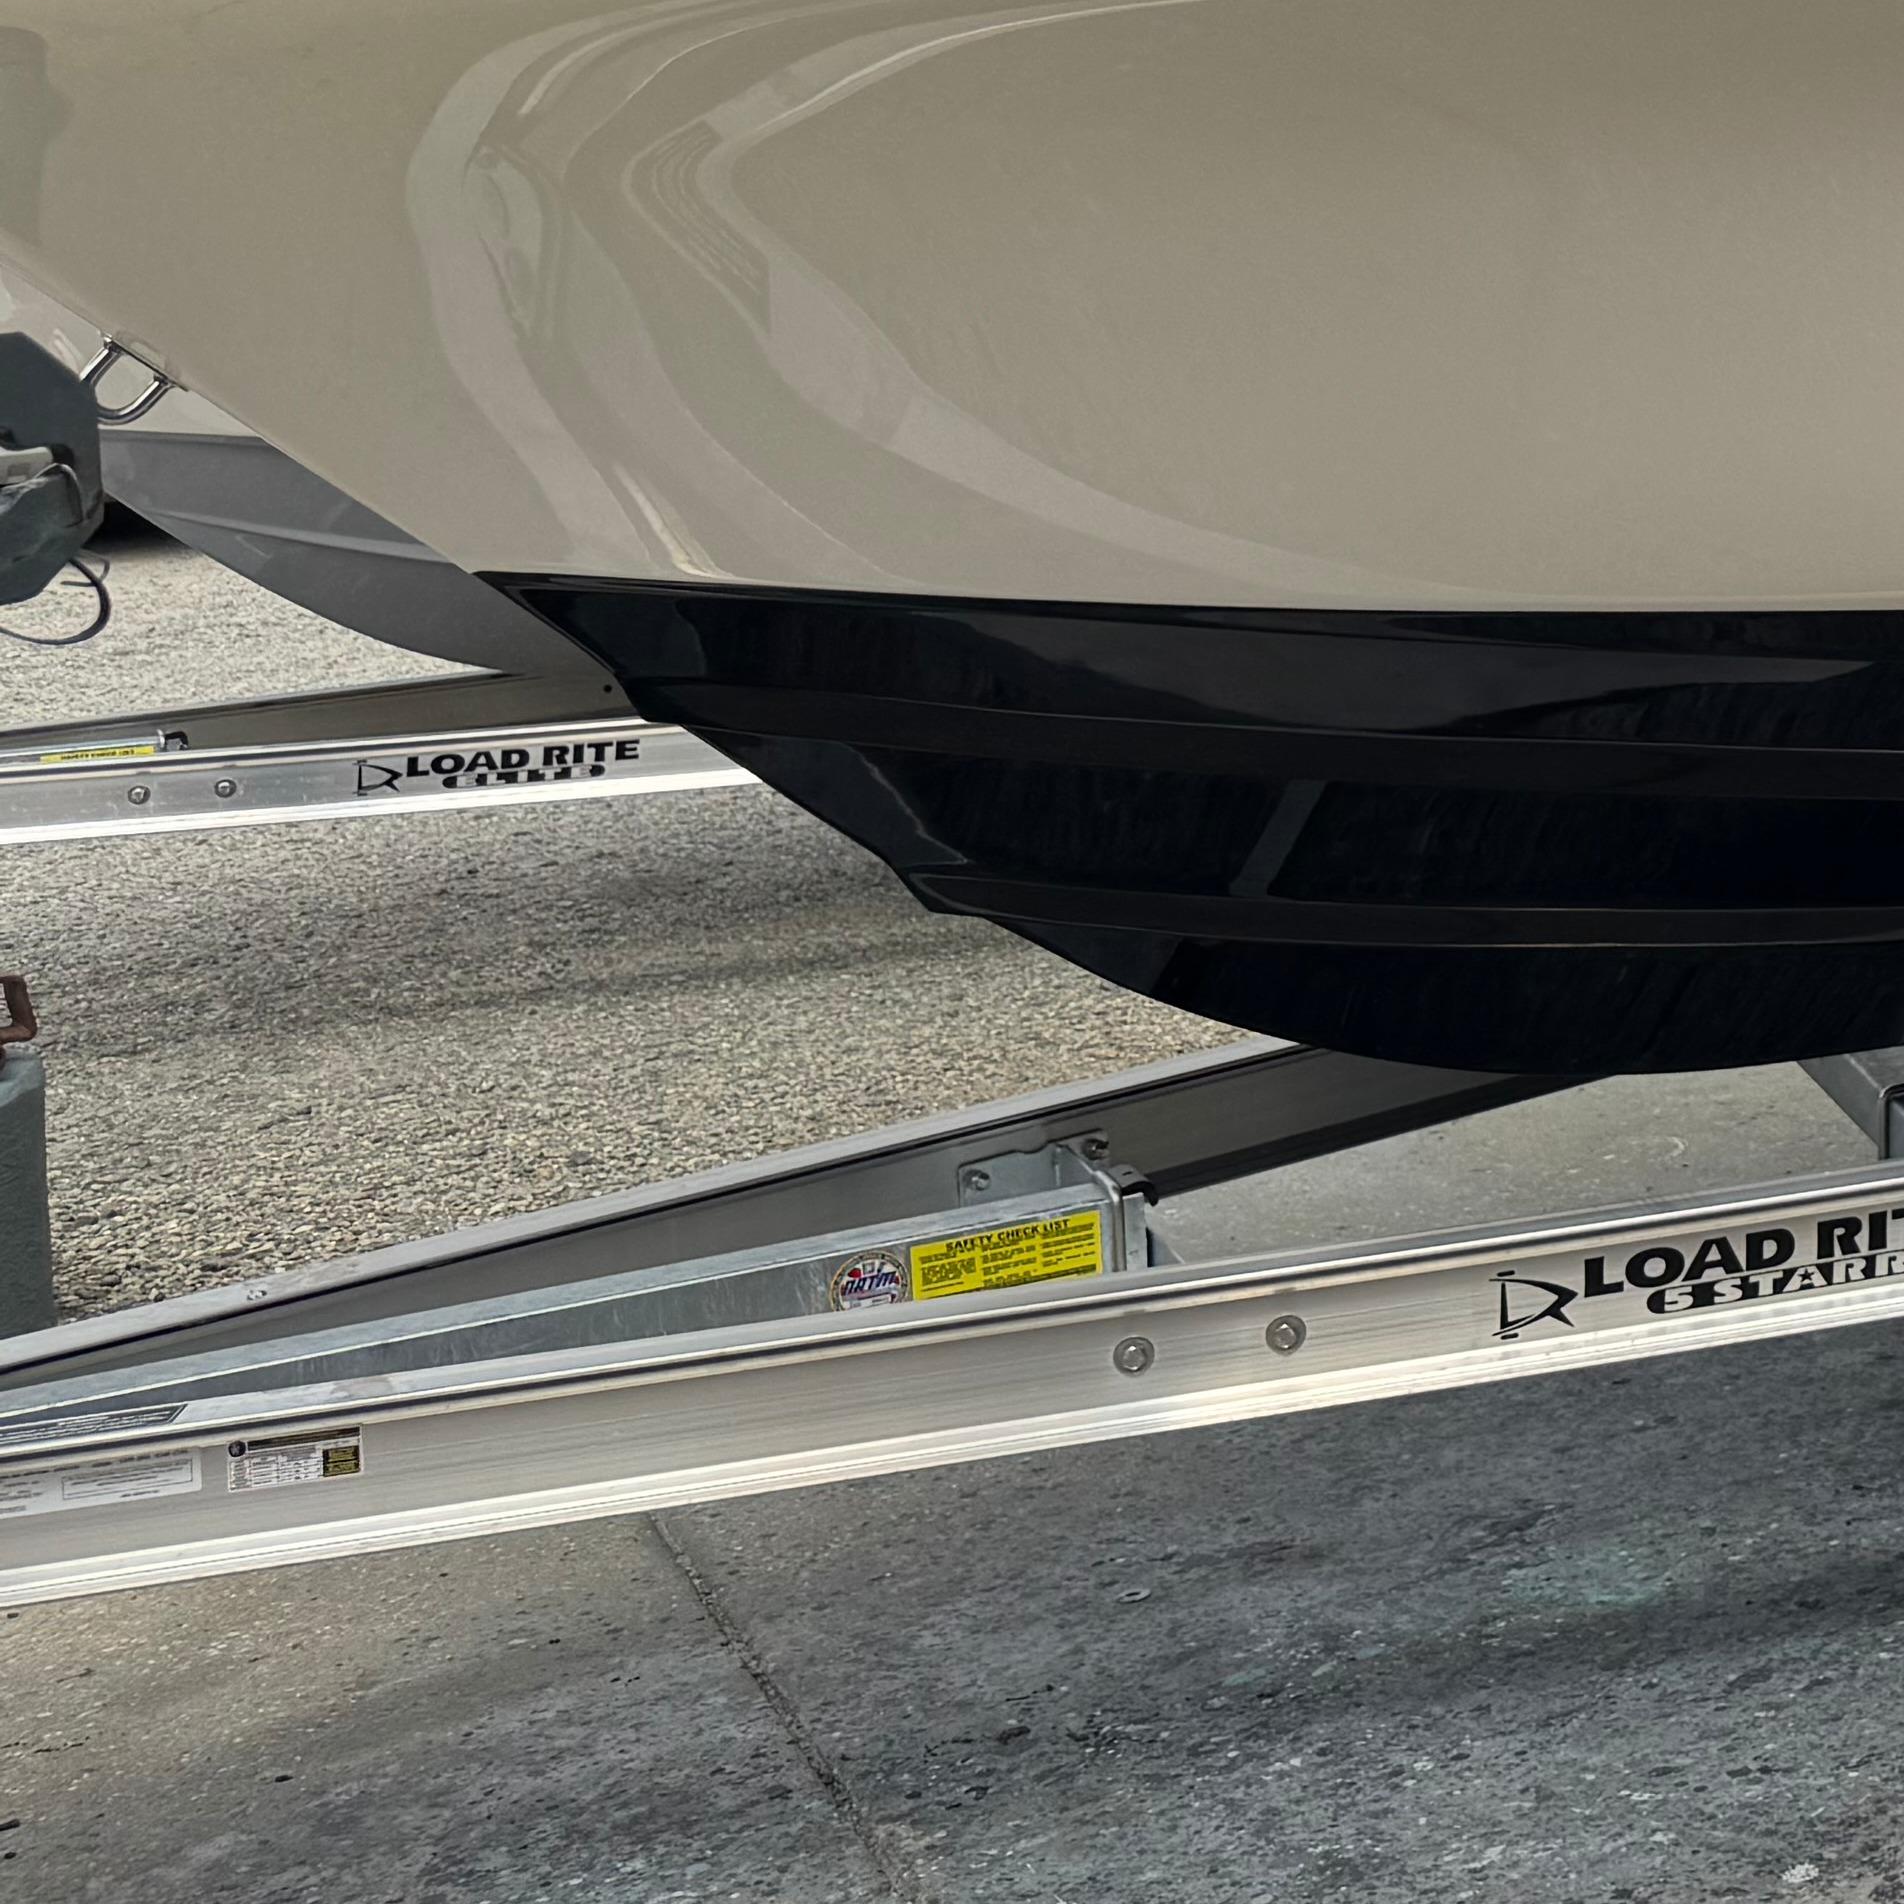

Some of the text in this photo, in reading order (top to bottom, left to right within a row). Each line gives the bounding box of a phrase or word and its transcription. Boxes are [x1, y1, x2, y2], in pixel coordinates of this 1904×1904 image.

[406, 738, 640, 778] LOAD RITE
[997, 1225, 1041, 1242] CHECK
[1043, 1218, 1070, 1234] LIST
[1584, 1228, 1796, 1298] LOAD
[1663, 1286, 1695, 1313] 5
